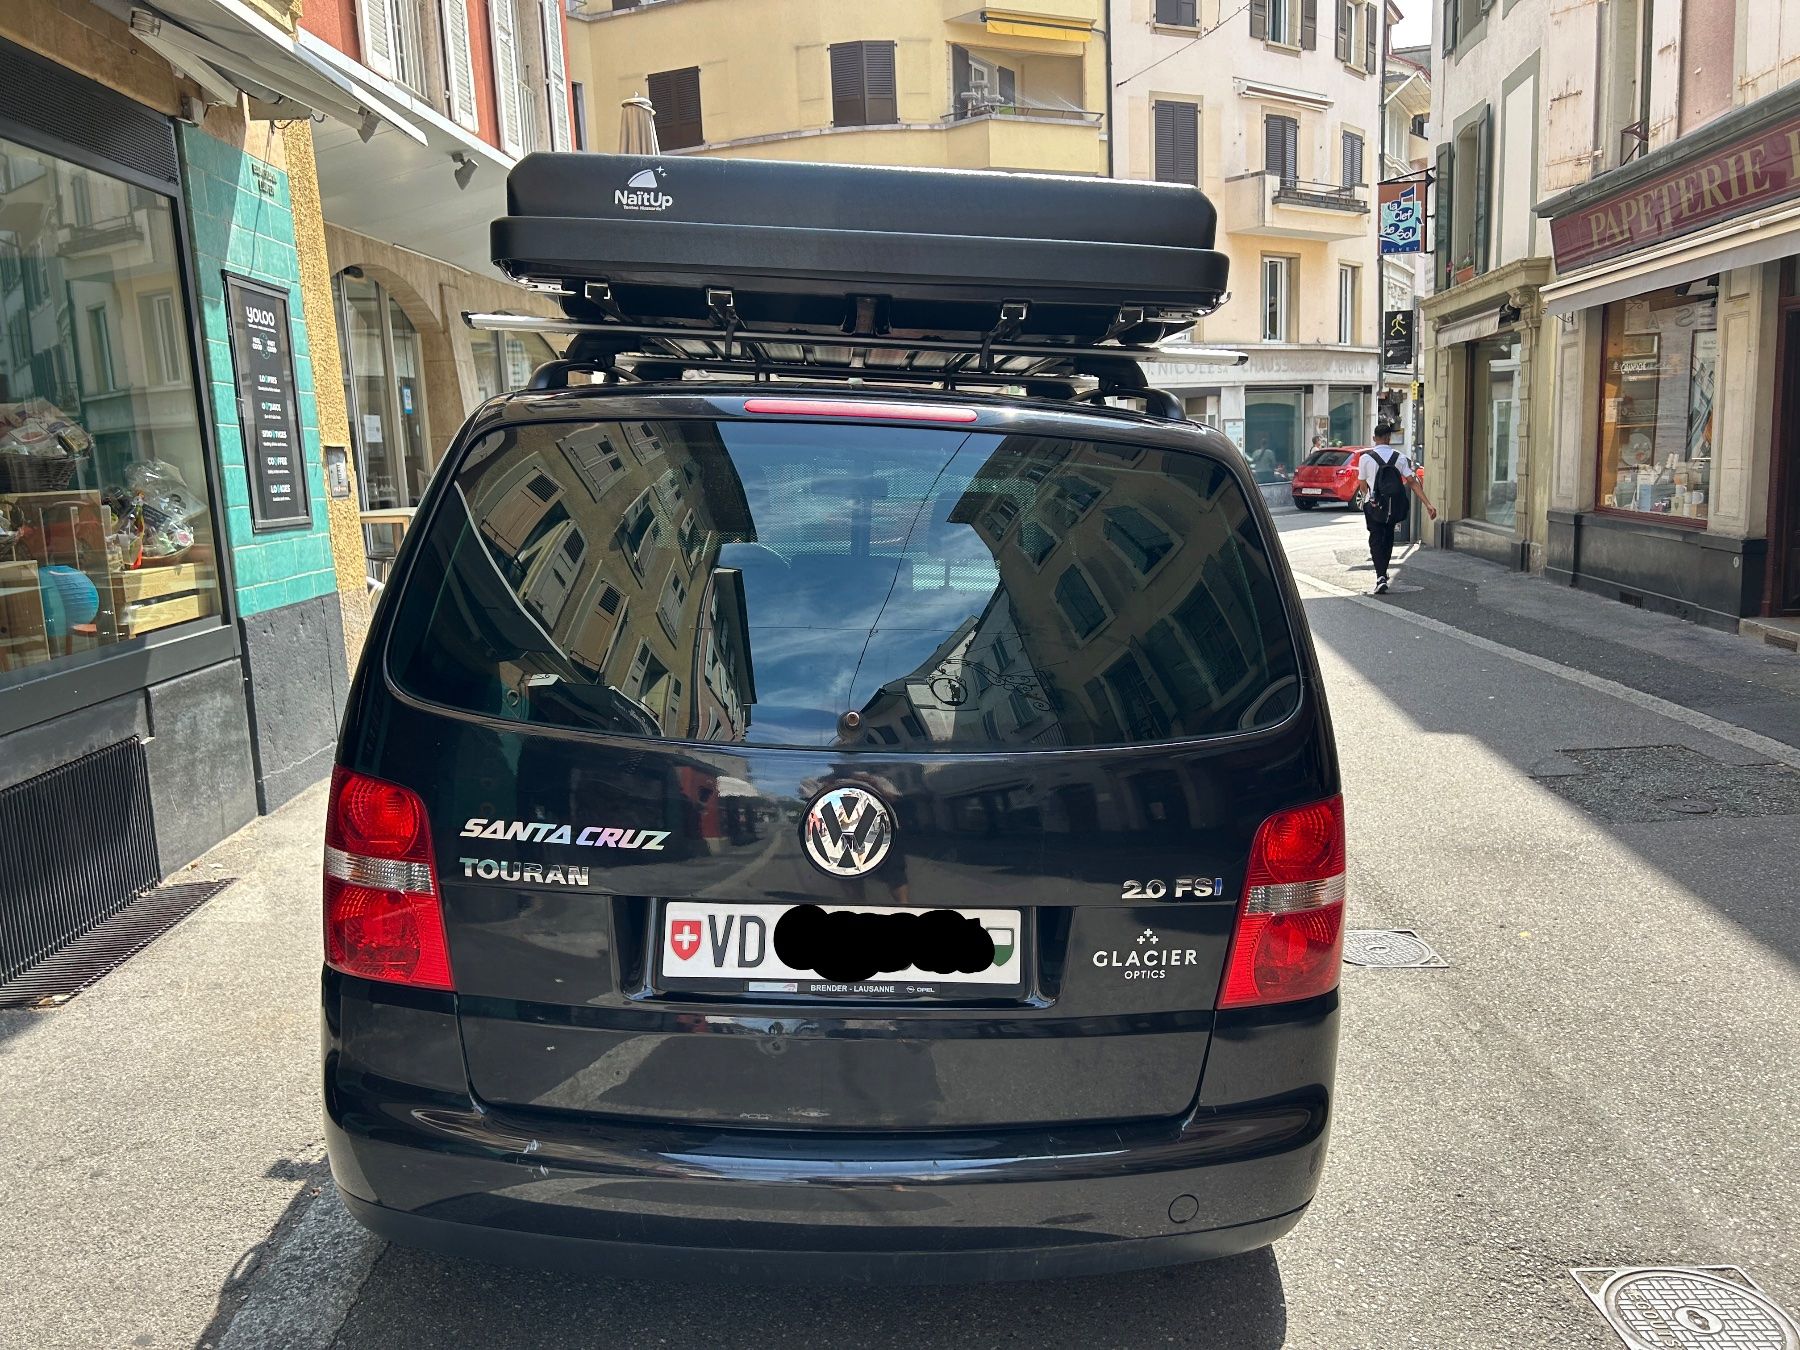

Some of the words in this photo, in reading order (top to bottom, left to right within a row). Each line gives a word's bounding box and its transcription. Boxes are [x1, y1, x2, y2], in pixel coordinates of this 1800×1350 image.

[614, 190, 673, 210] NaïtUp
[1588, 144, 1771, 251] PAPETERIE
[1394, 210, 1413, 221] Clef
[1397, 229, 1413, 239] Sol
[245, 306, 275, 327] YOLOO
[459, 818, 571, 845] SANTA
[575, 826, 672, 850] CRUZ
[459, 857, 590, 886] TOURAN
[1174, 877, 1223, 898] FSI
[708, 914, 766, 968] VD
[1092, 949, 1198, 967] GLACIER
[1124, 970, 1166, 979] OPTICS
[810, 984, 847, 992] BRENDER
[853, 985, 895, 993] LAUSANNE
